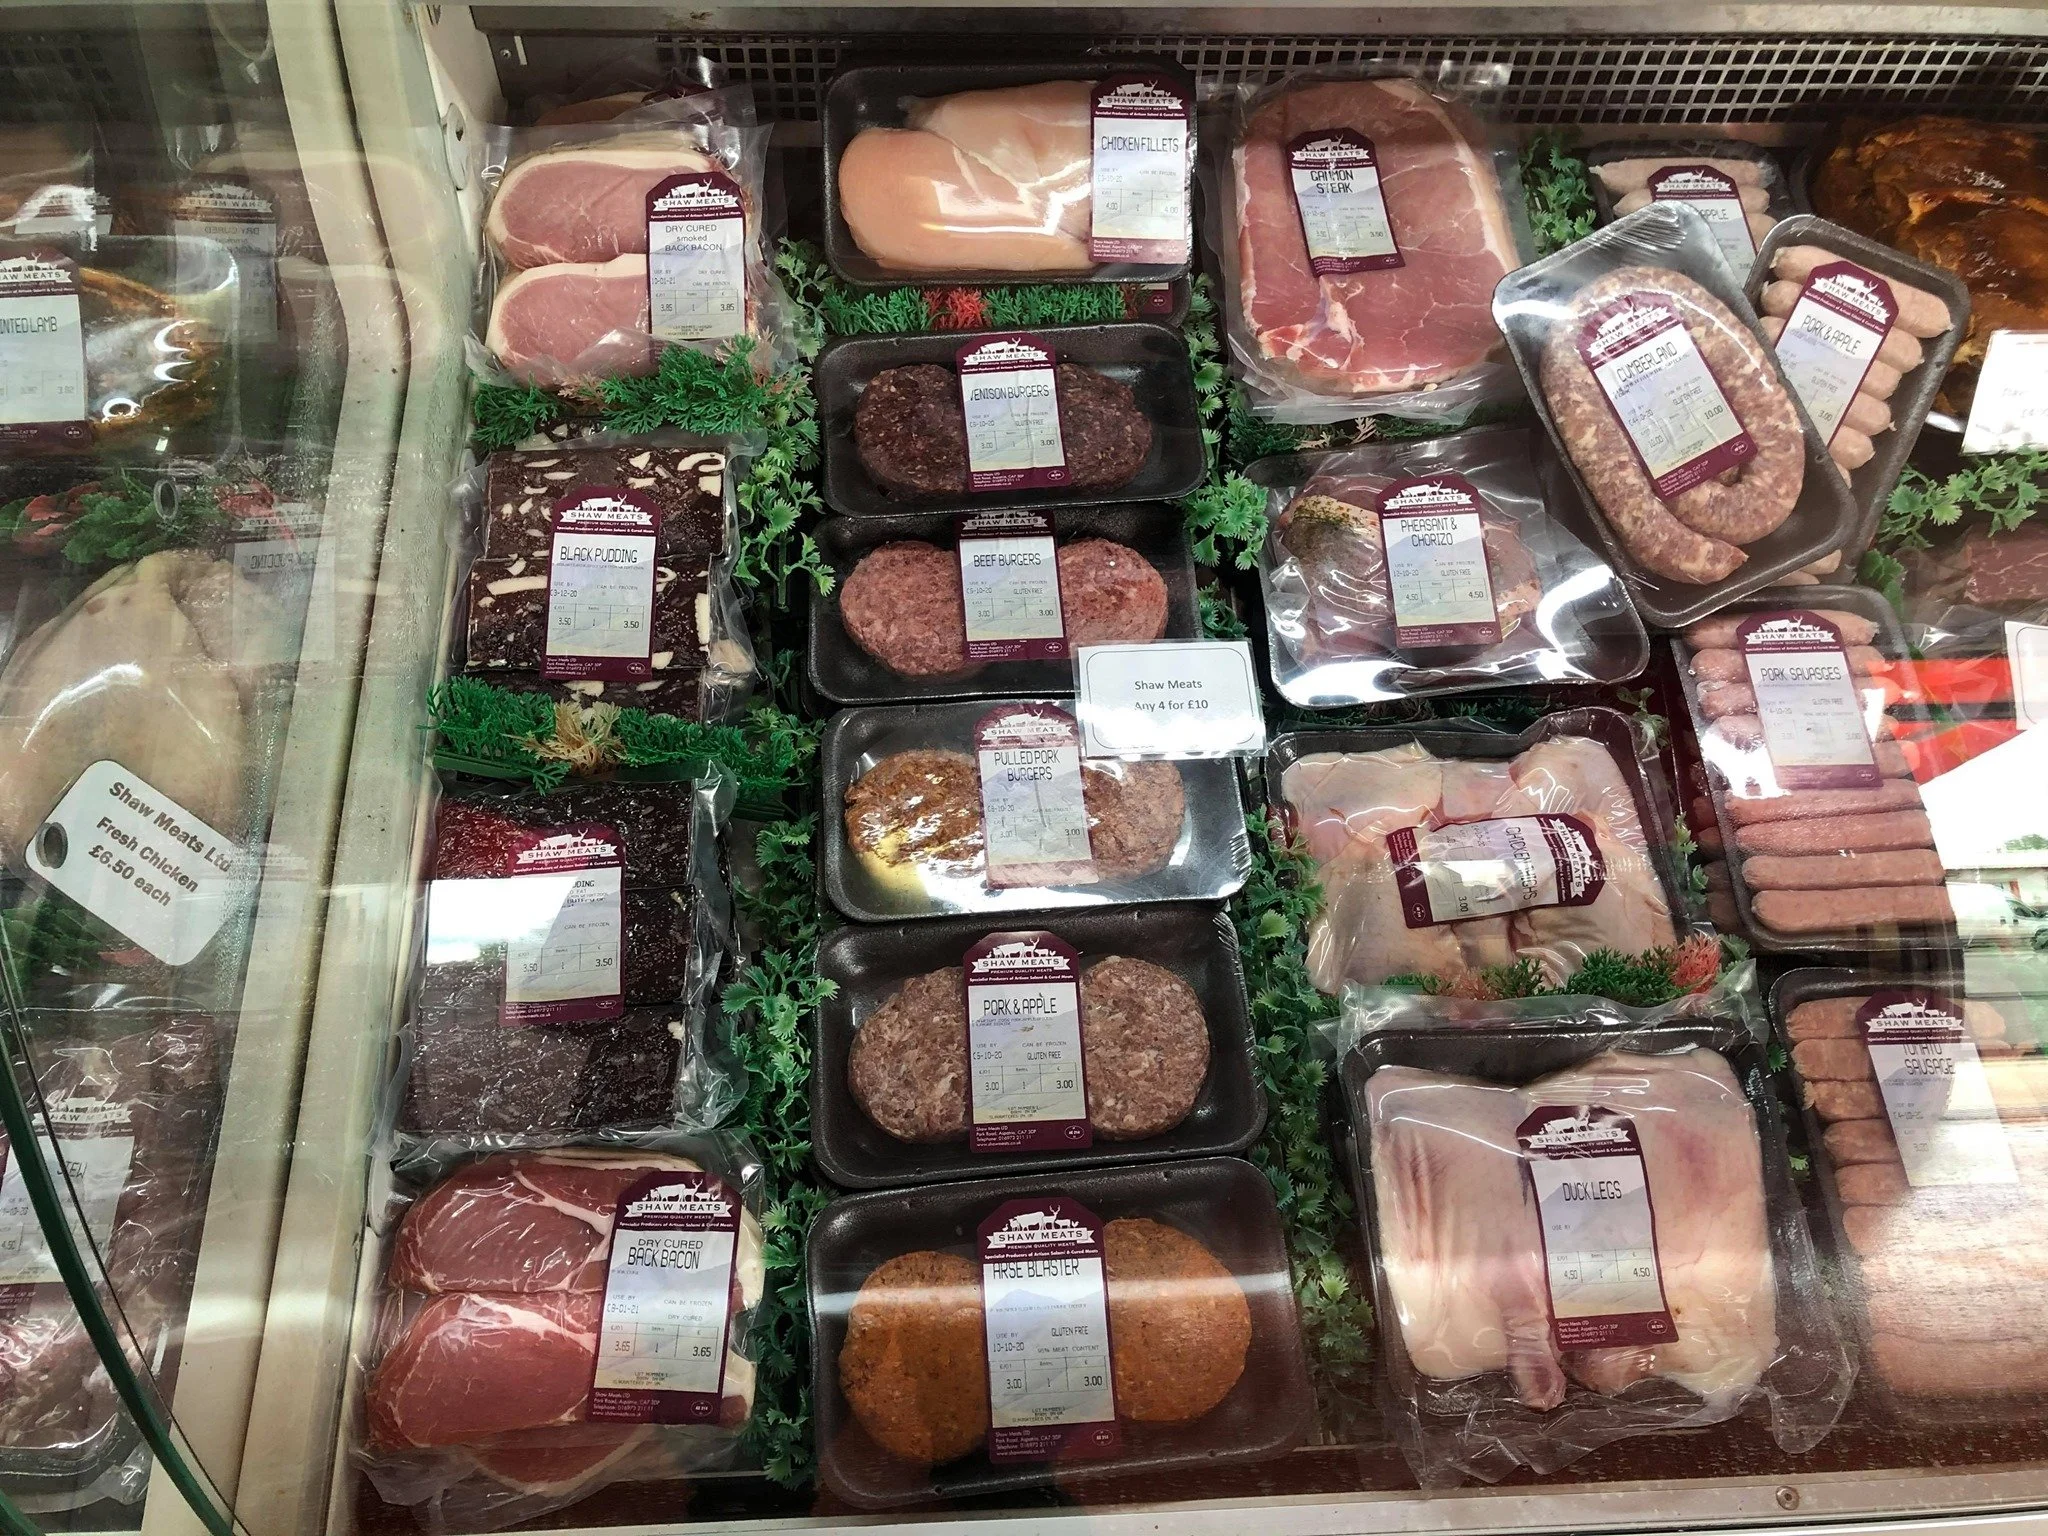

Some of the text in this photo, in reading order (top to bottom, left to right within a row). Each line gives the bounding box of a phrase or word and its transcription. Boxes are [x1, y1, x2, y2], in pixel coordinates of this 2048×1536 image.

[1101, 136, 1179, 152] CHICKEN FILLETS
[1311, 170, 1354, 181] GAMMON
[1317, 183, 1353, 193] STEAK
[1823, 282, 1882, 315] SHAW MEATS
[0, 316, 57, 334] INTED LAMB
[1596, 331, 1624, 349] SHAW
[1802, 315, 1824, 339] PORK
[1824, 327, 1831, 339] &
[1830, 330, 1861, 355] APPLE
[1617, 341, 1678, 382] CUMBERLAND
[1008, 385, 1049, 398] BURGERS
[1704, 405, 1723, 420] 10.00
[1818, 410, 1833, 422] 3.00
[1401, 517, 1457, 532] PHEASANT &
[1412, 533, 1453, 547] CHORIZO
[561, 546, 638, 563] BLACK PUDDING
[974, 553, 1041, 567] BEEF BURGERS
[558, 617, 640, 629] 3.50 3.50
[1761, 667, 1841, 681] PORK SAUASGES
[1135, 680, 1202, 690] Shaw Meats
[1135, 700, 1208, 712] Any 4 for £10
[994, 750, 1060, 766] PULLED PORK
[1008, 767, 1052, 781] BURGERS
[109, 781, 232, 873] Shaw Meats Ltd
[1065, 828, 1080, 836] 3.00
[96, 816, 199, 893] Fresh Chicken
[1558, 826, 1582, 887] SHAW MEATS
[88, 844, 172, 907] £6.50 each
[1458, 896, 1469, 912] 3.00
[523, 958, 613, 972] 3.50 3.50
[984, 998, 1057, 1015] PORK & APPLE
[1027, 1052, 1047, 1060] GLUTEN
[1903, 1044, 1942, 1055] TOMATO
[1905, 1058, 1955, 1075] SAUSAGE
[985, 1080, 1073, 1091] 3.00 3.00
[1578, 1131, 1618, 1139] MEATS
[1563, 1180, 1622, 1201] DUCK LEGS
[999, 1231, 1083, 1242] SHAW MEATS
[638, 1239, 703, 1249] DRY CURED
[628, 1247, 700, 1269] BACK BACON
[993, 1259, 1079, 1279] ARSE BLASTER
[1564, 1267, 1650, 1280] 4.50 4.50
[1052, 1326, 1088, 1337] GLUTEN FREE
[615, 1341, 712, 1357] 3.65 3.65
[993, 1342, 1024, 1352] 10-10-20
[1007, 1376, 1102, 1389] 3.00 3.00
